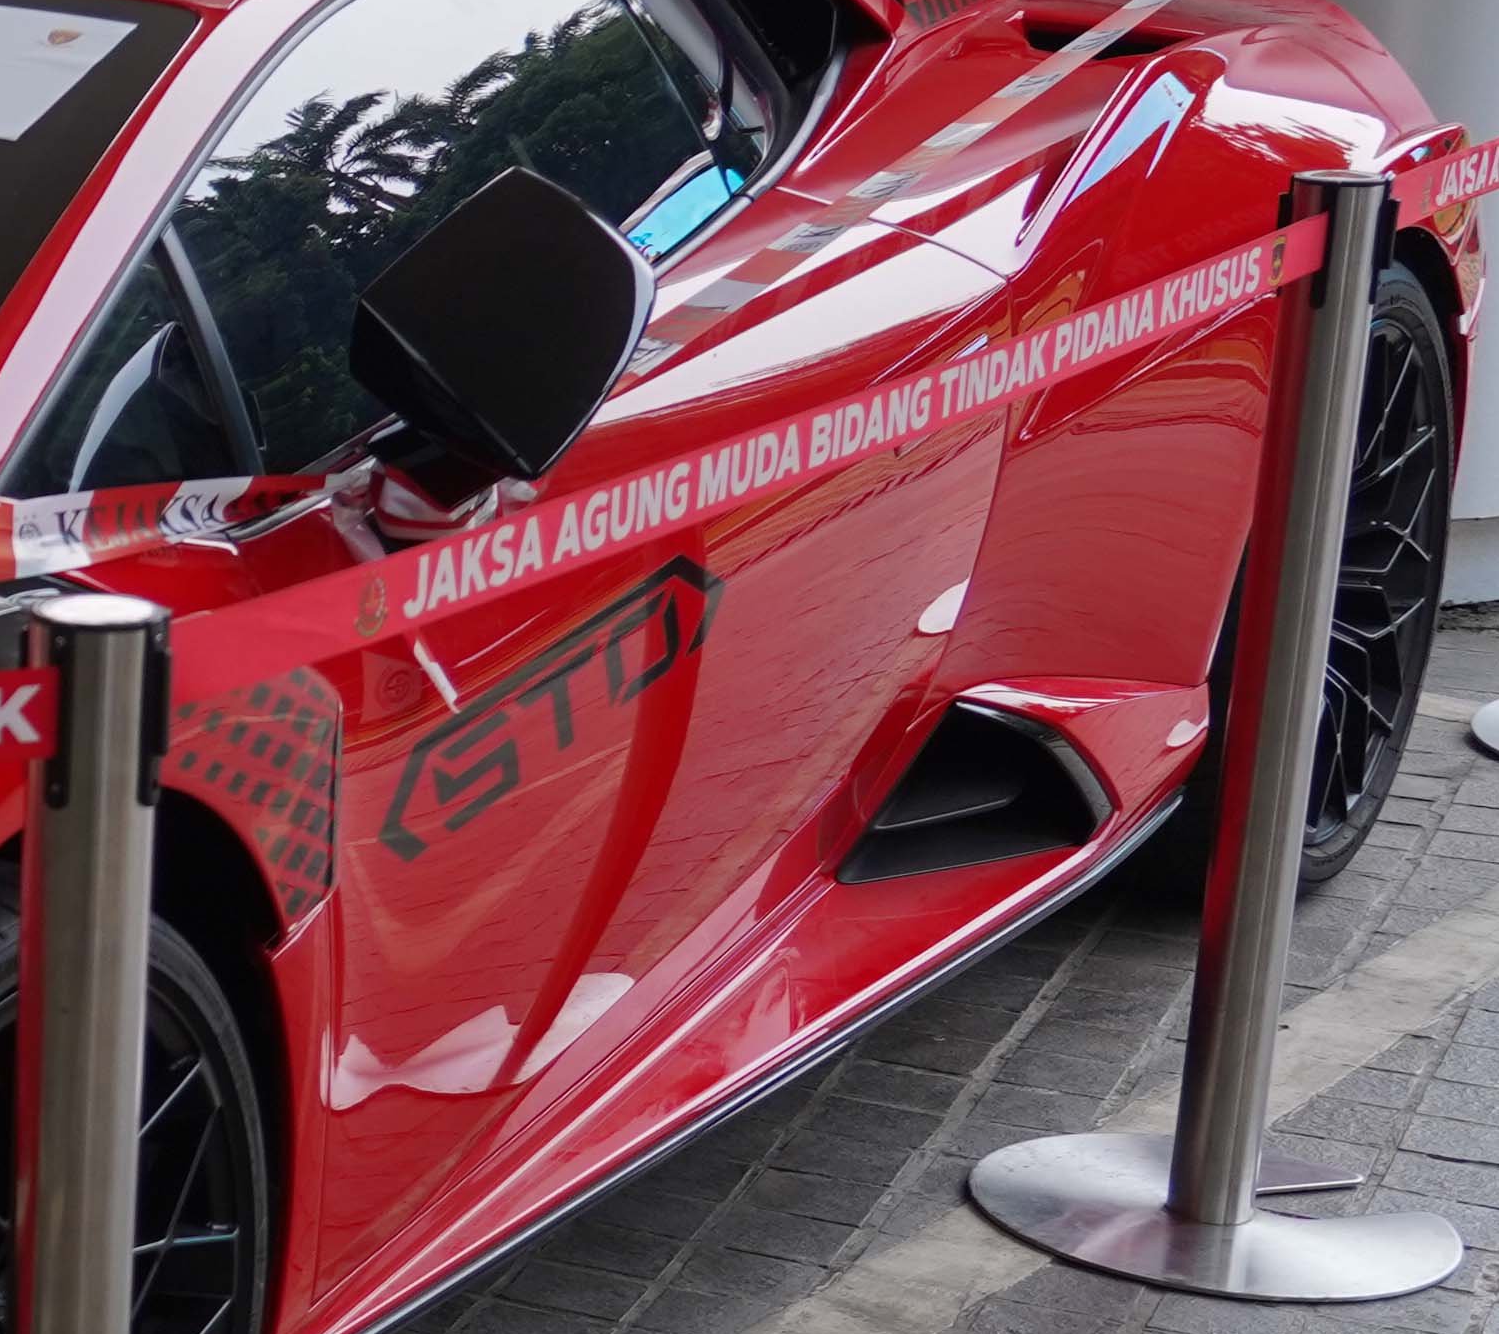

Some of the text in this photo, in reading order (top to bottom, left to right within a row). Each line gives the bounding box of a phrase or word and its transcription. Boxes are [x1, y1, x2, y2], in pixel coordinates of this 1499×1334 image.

[403, 245, 1262, 620] JAKSA AGUNG MUDA BIDANG TINDAK PIDANA KHUSUS
[433, 581, 684, 833] STO
